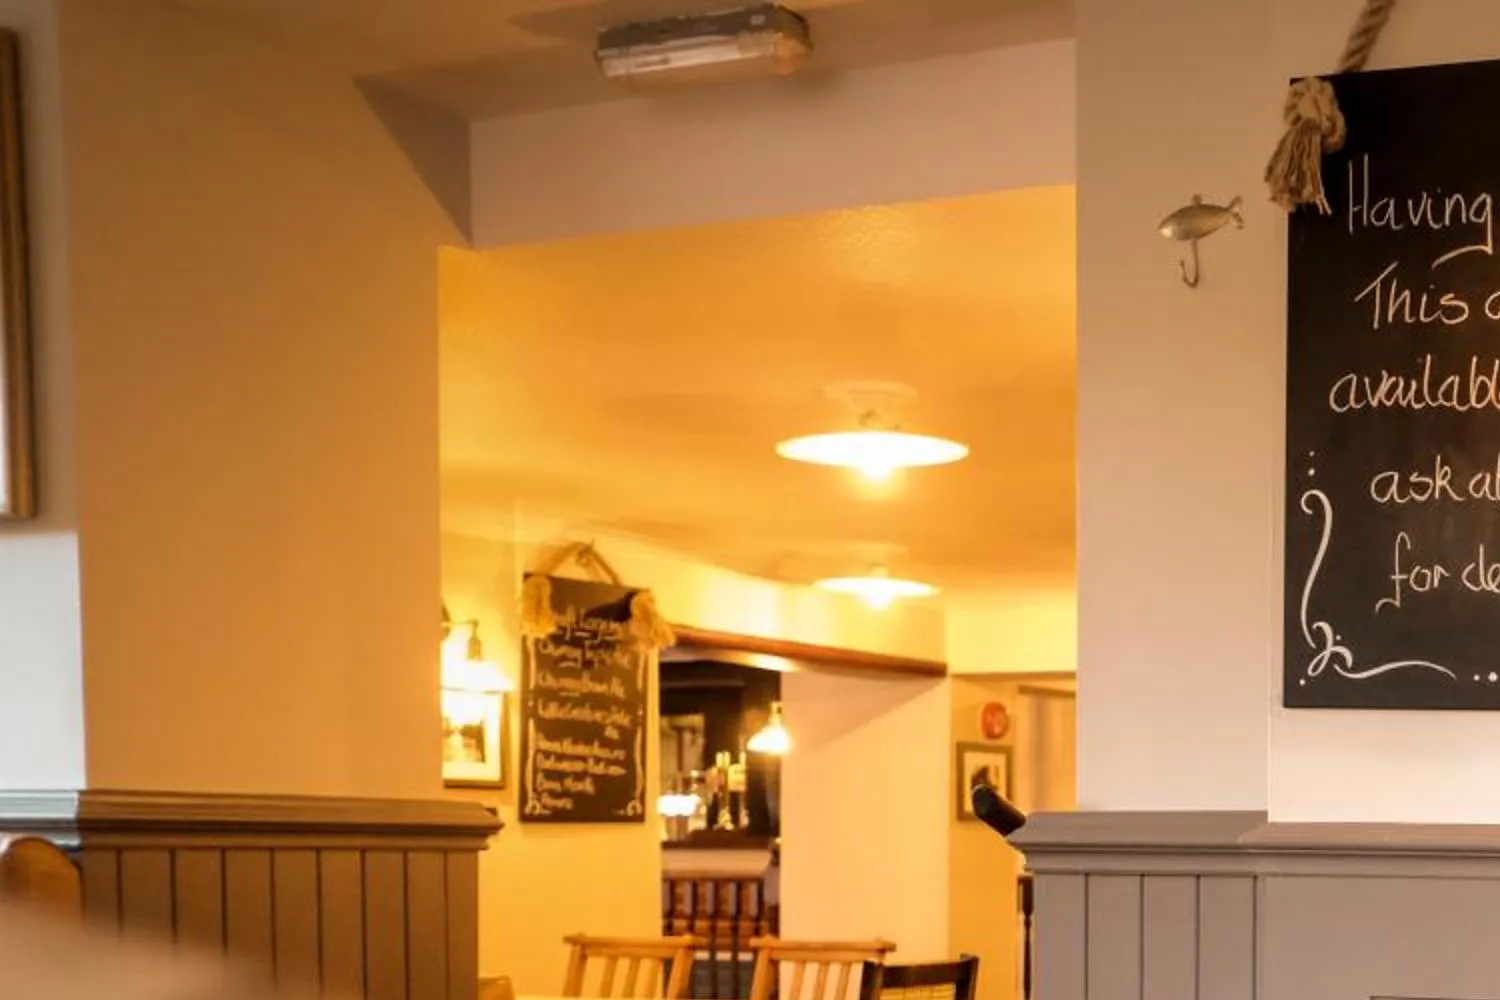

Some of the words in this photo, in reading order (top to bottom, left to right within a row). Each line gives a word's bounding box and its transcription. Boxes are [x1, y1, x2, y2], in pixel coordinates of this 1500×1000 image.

[1349, 153, 1493, 269] Having
[1354, 261, 1470, 330] This
[1370, 454, 1464, 503] ask
[1375, 532, 1451, 614] for
